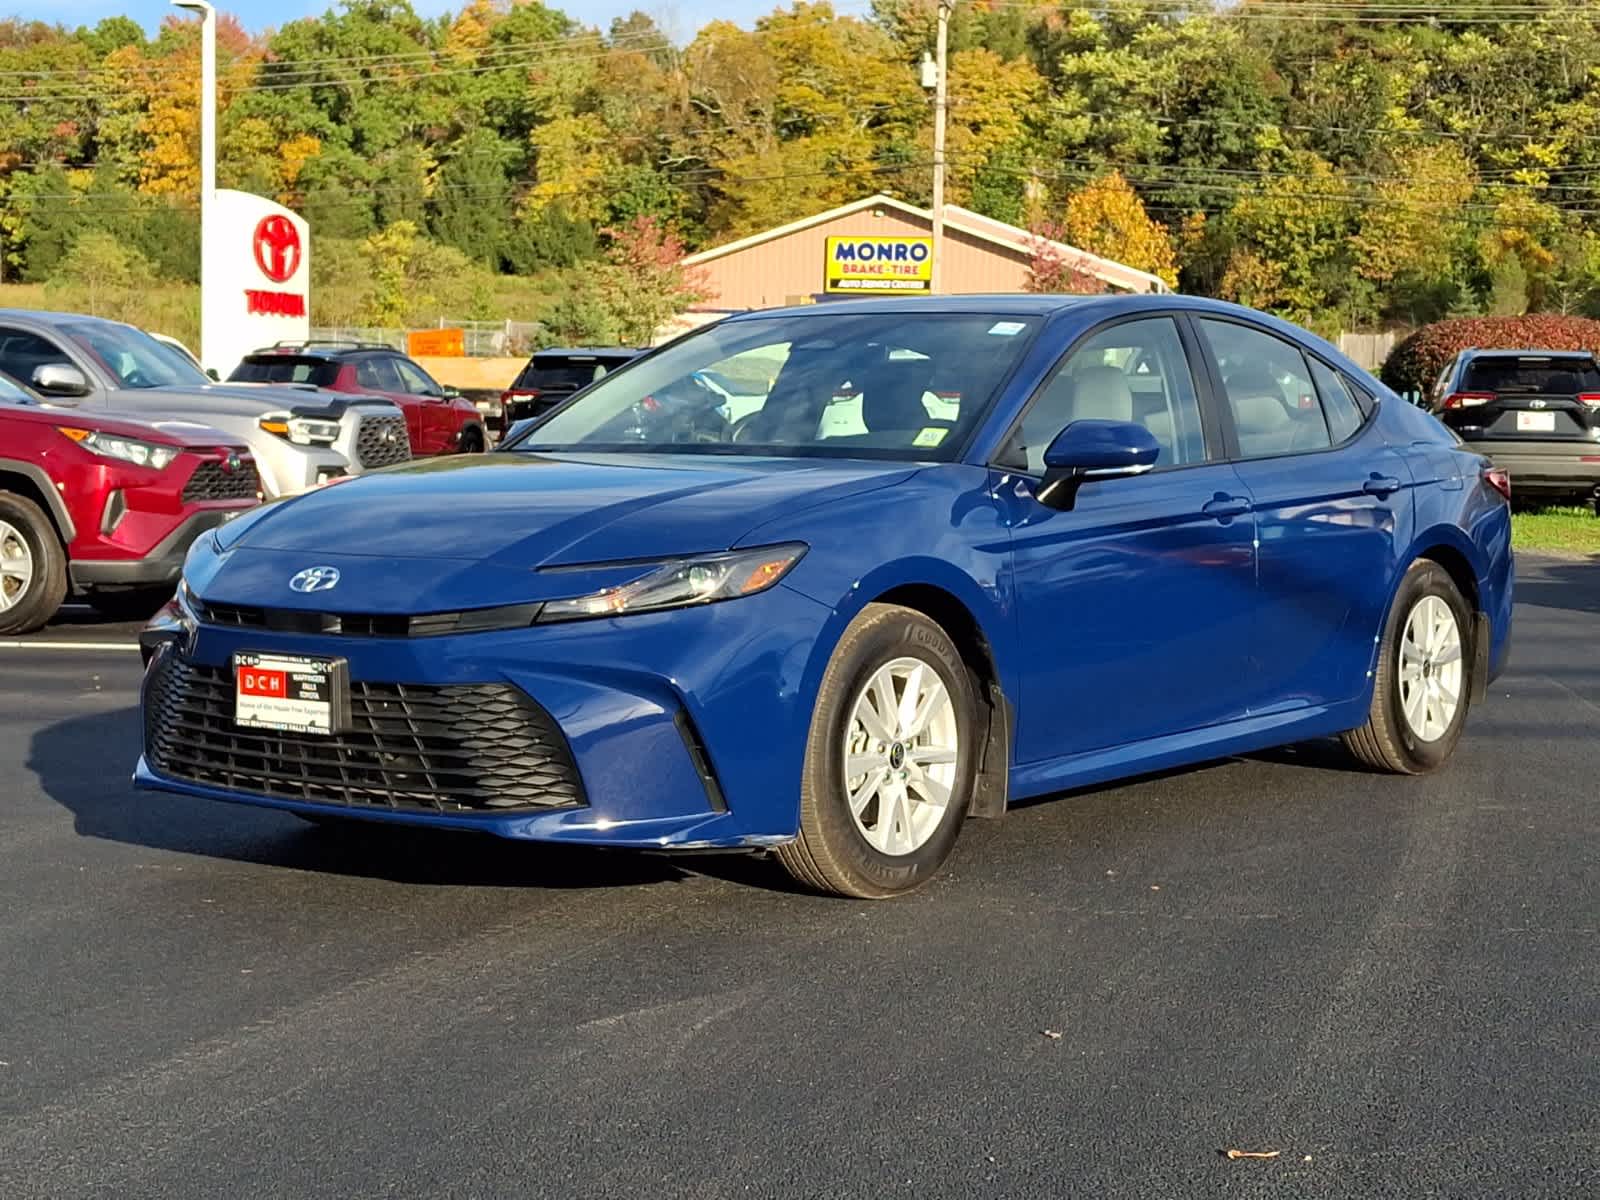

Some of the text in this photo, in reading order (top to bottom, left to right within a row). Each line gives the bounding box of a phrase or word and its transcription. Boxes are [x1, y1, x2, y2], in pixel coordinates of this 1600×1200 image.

[835, 242, 928, 262] MONRO
[842, 263, 920, 275] BRAKE TIRE
[235, 655, 254, 666] DCH
[244, 674, 279, 691] DCH
